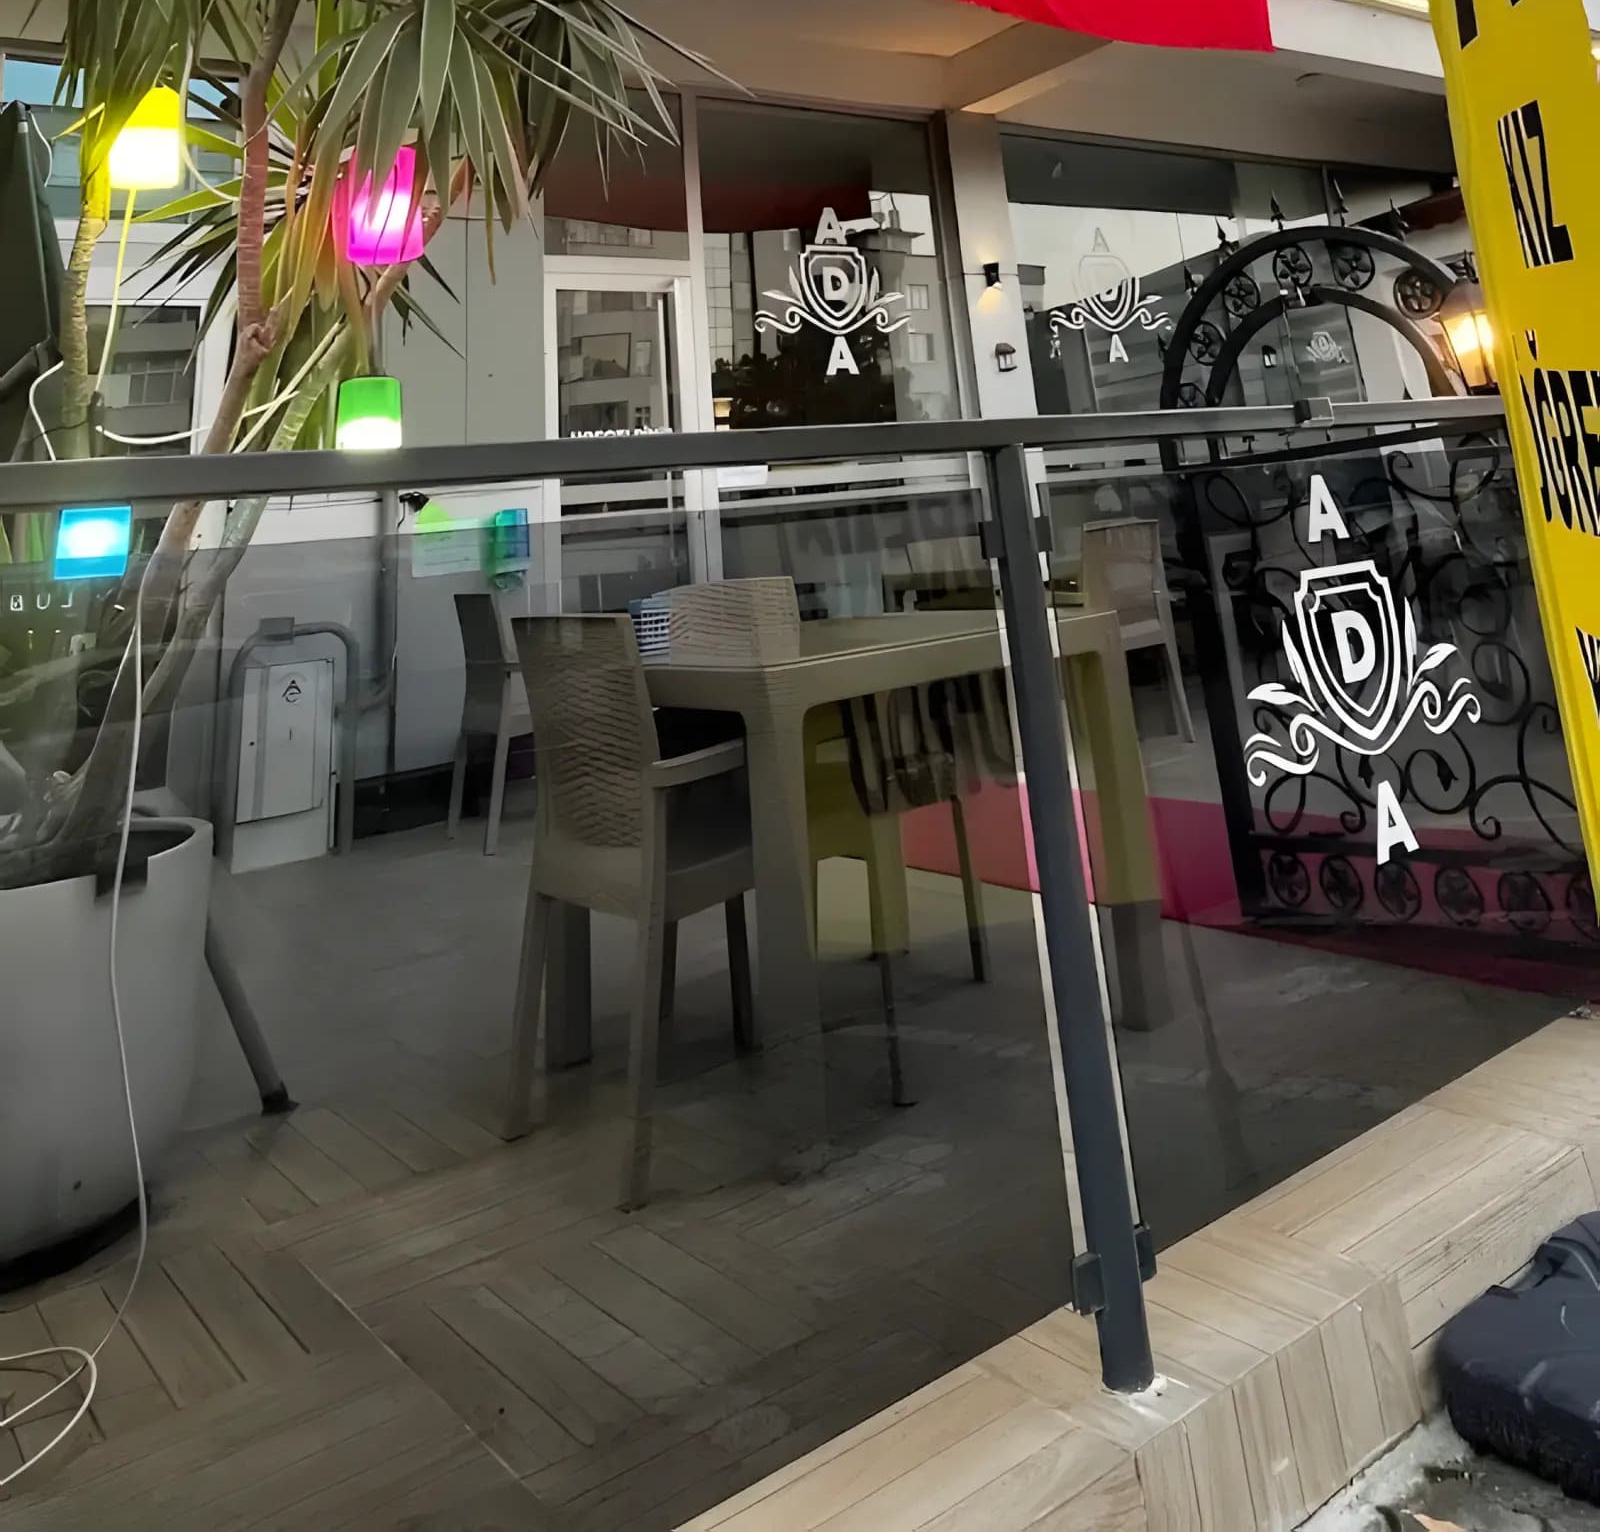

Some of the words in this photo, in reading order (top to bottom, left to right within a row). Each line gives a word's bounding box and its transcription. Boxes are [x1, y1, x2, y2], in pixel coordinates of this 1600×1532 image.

[1498, 100, 1574, 269] KIZ
[814, 207, 860, 375] ADA
[1308, 474, 1419, 865] ADA
